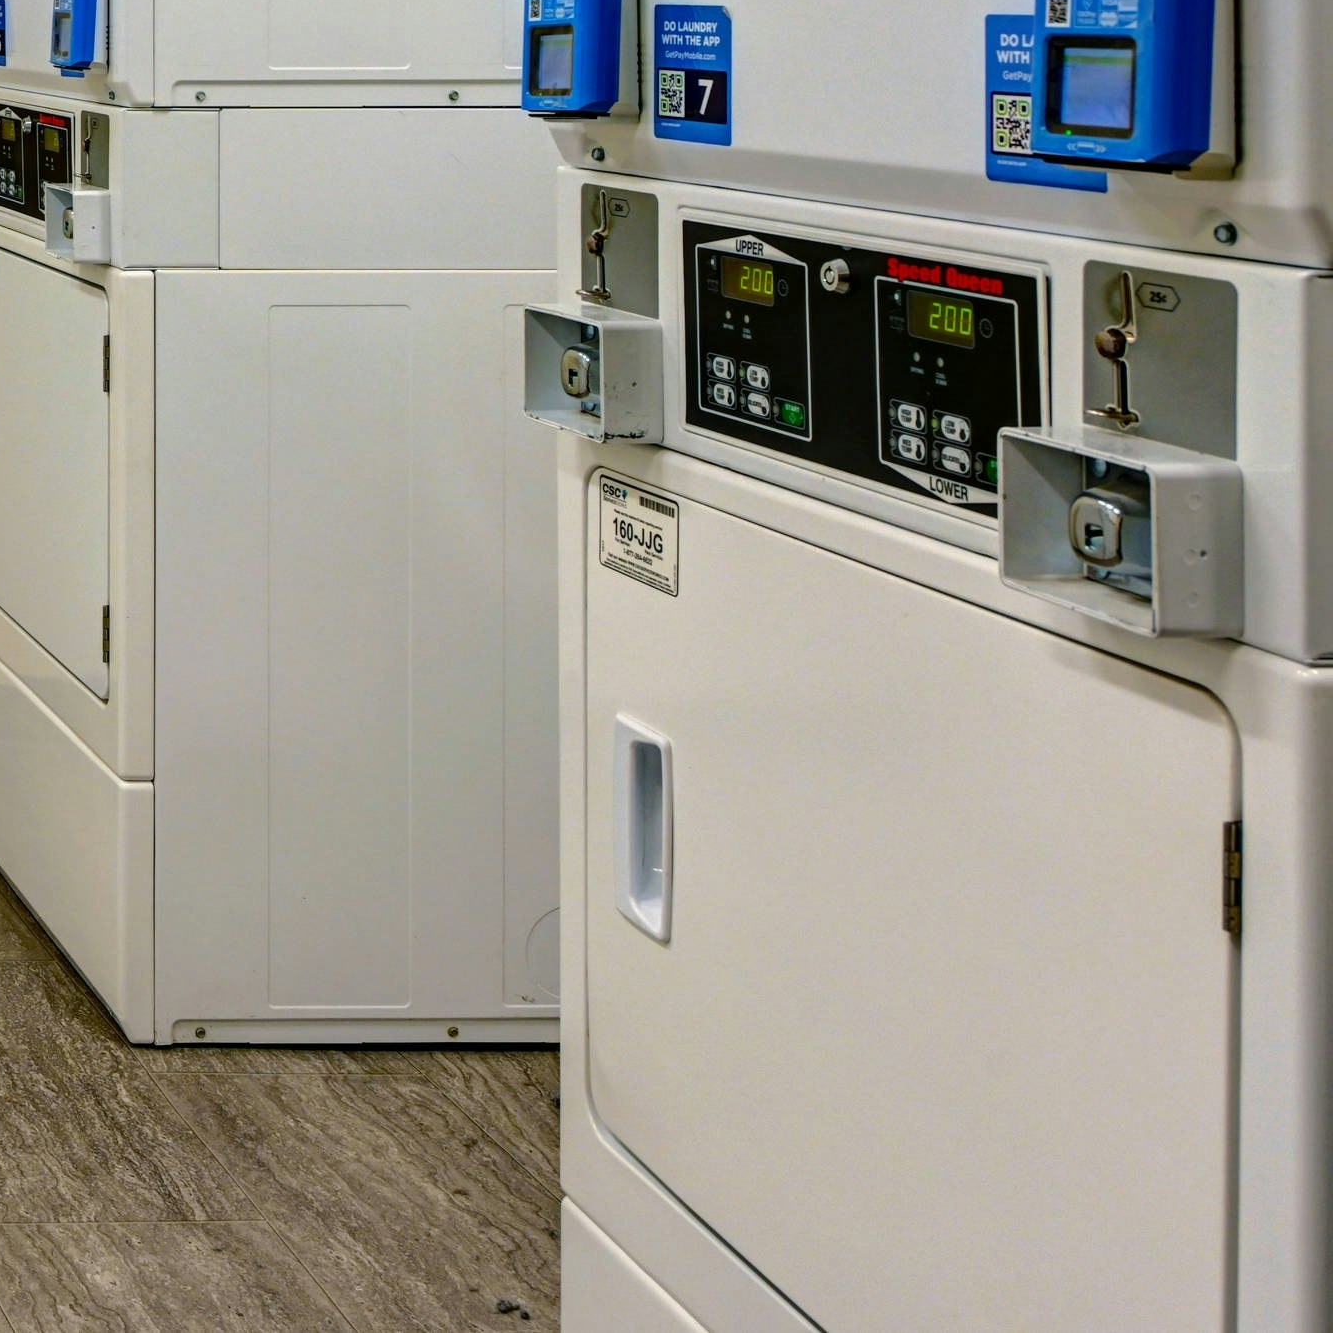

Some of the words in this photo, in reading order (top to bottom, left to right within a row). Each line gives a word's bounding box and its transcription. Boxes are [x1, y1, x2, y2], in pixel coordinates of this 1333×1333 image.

[664, 21, 676, 32] DO
[678, 21, 718, 33] LAUNDRY
[661, 34, 683, 45] WITH
[685, 35, 701, 46] THE
[703, 36, 721, 47] APP
[1000, 34, 1019, 47] DO
[997, 50, 1030, 64] WITH
[698, 78, 714, 115] 7
[735, 239, 764, 256] UPPER
[740, 266, 773, 295] 200
[887, 257, 941, 283] Speed
[946, 267, 1003, 295] Queen
[929, 302, 972, 335] 200
[602, 483, 622, 498] CSC
[929, 476, 968, 502] LOWER
[613, 517, 663, 554] 160-JJG
